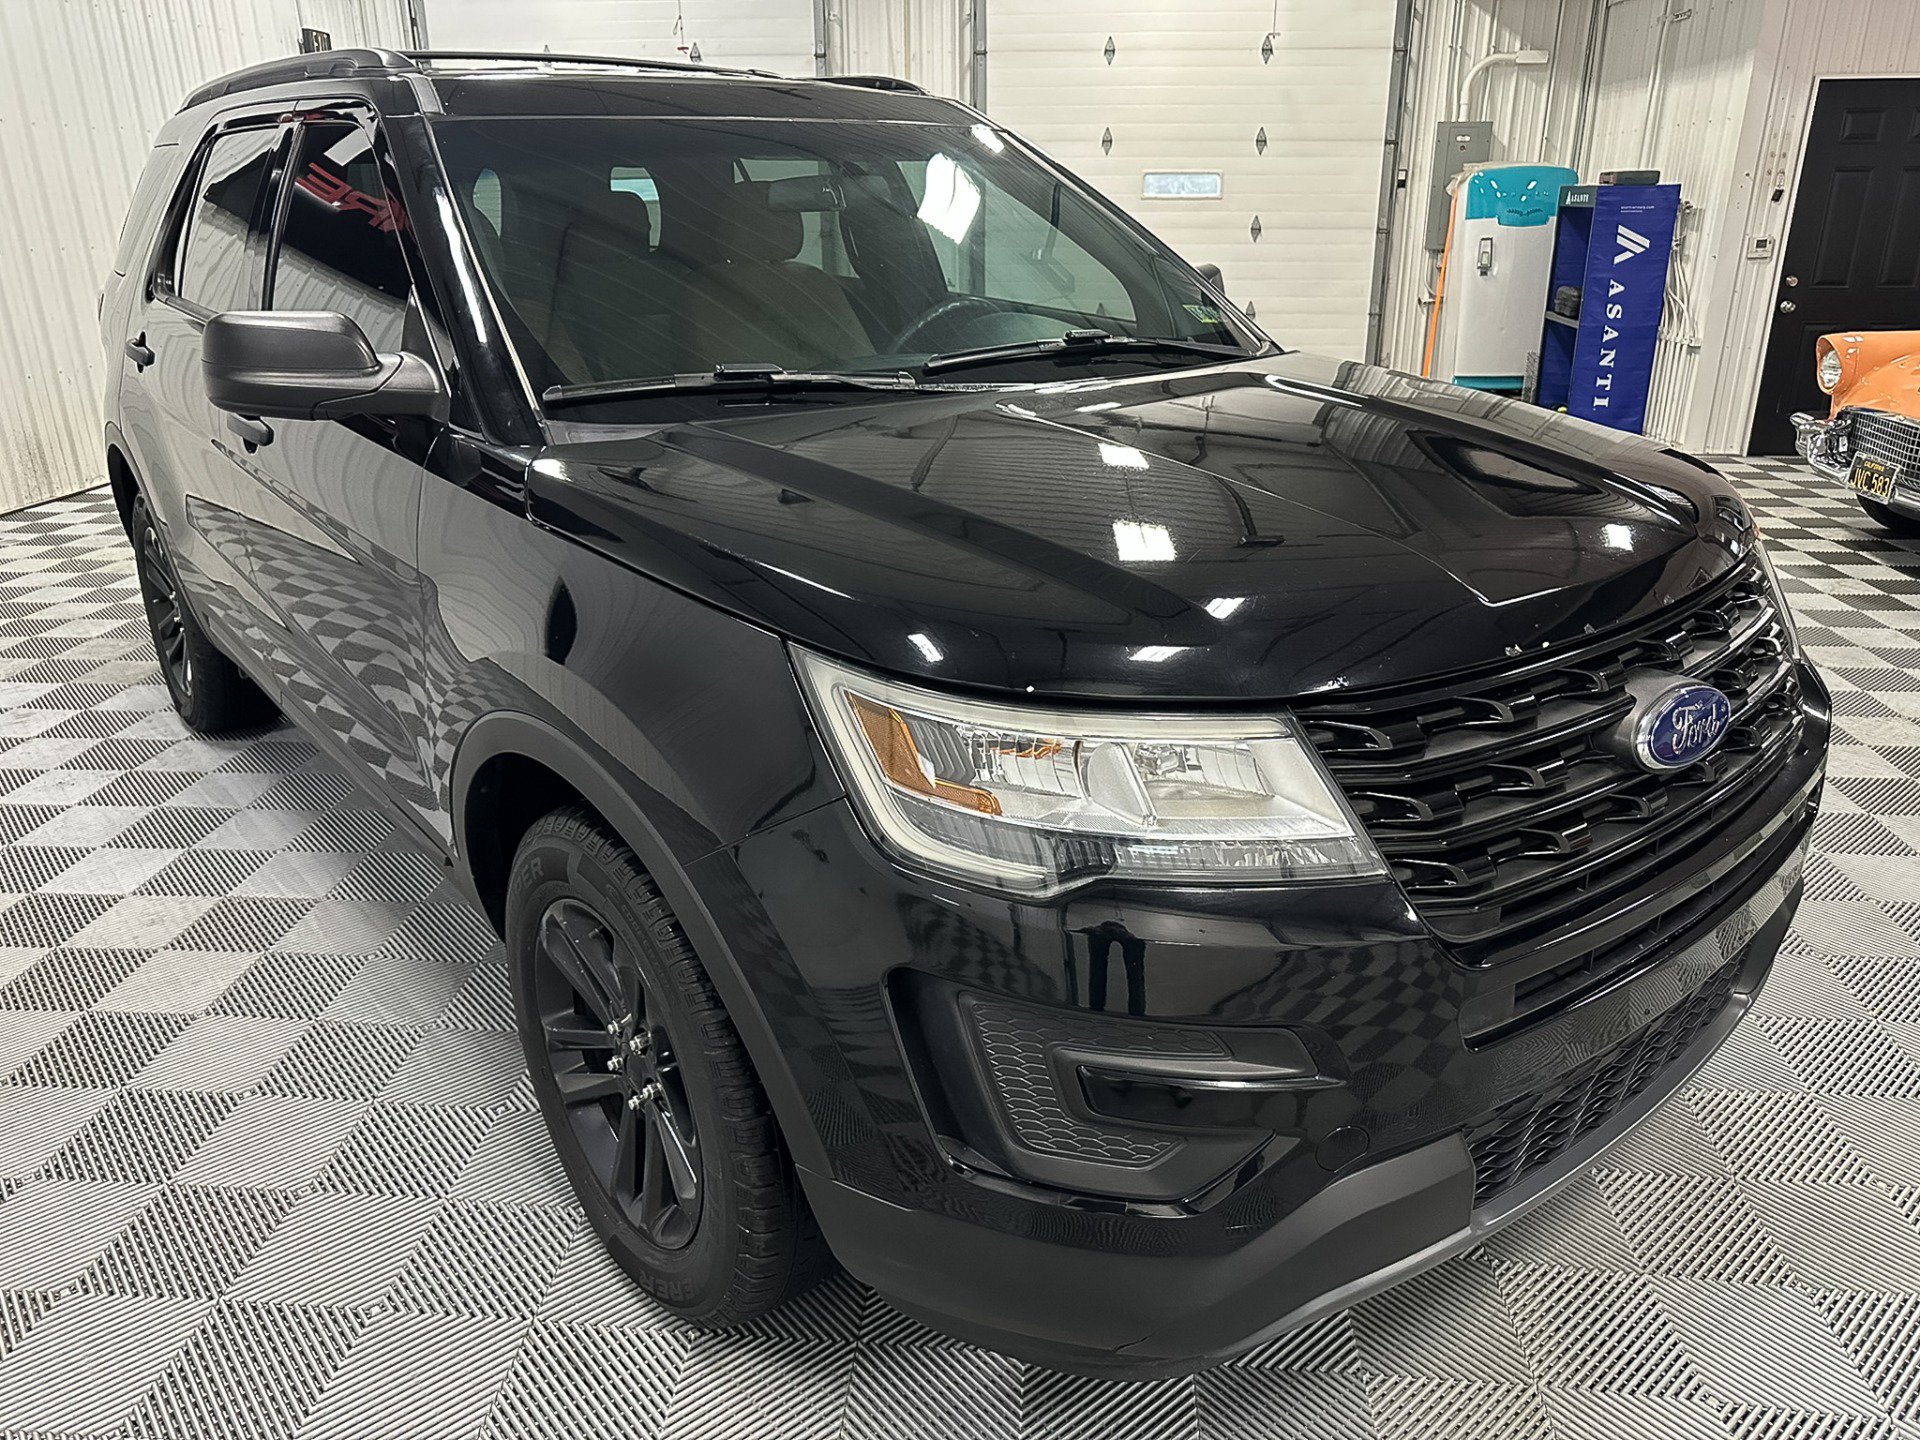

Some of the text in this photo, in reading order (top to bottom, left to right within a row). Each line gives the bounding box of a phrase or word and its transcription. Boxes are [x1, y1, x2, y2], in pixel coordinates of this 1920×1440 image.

[1593, 279, 1625, 407] ASANTI
[1850, 468, 1890, 496] JVC 583
[1672, 700, 1720, 755] Ford
